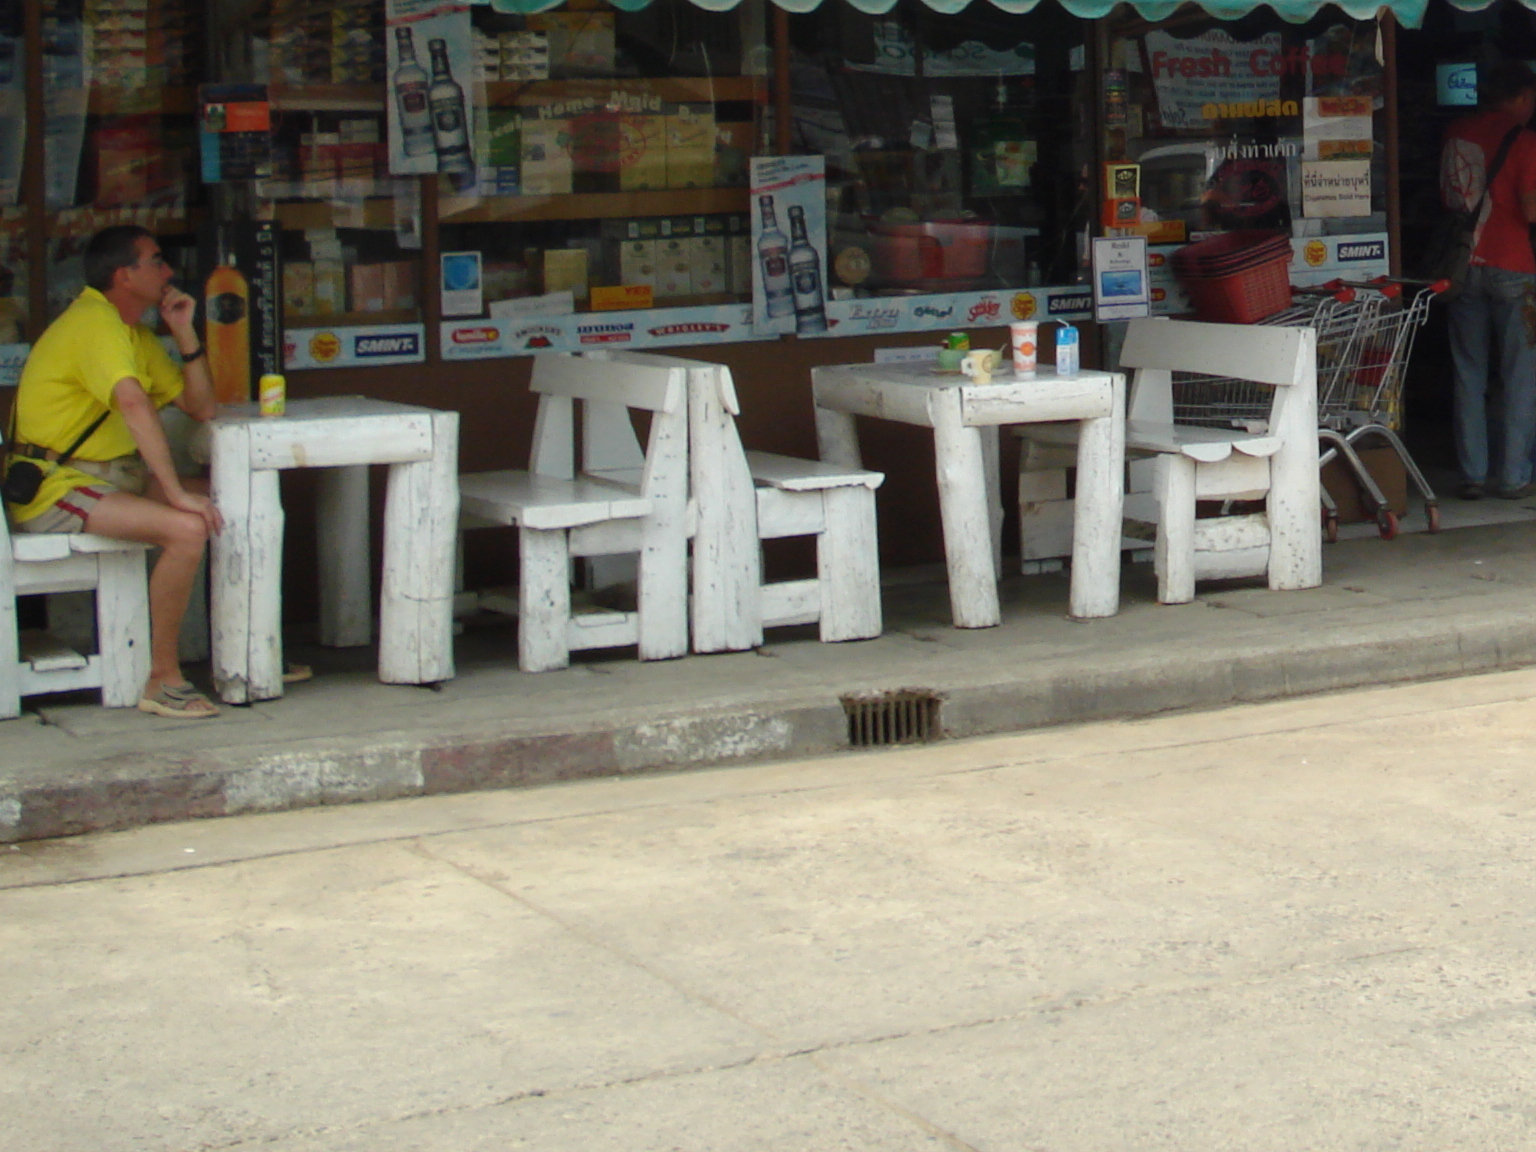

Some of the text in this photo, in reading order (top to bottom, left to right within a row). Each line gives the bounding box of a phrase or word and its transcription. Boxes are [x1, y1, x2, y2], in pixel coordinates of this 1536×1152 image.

[1152, 45, 1349, 79] Fresh Coffee
[1338, 245, 1380, 259] SMINT
[356, 339, 410, 354] SMINT
